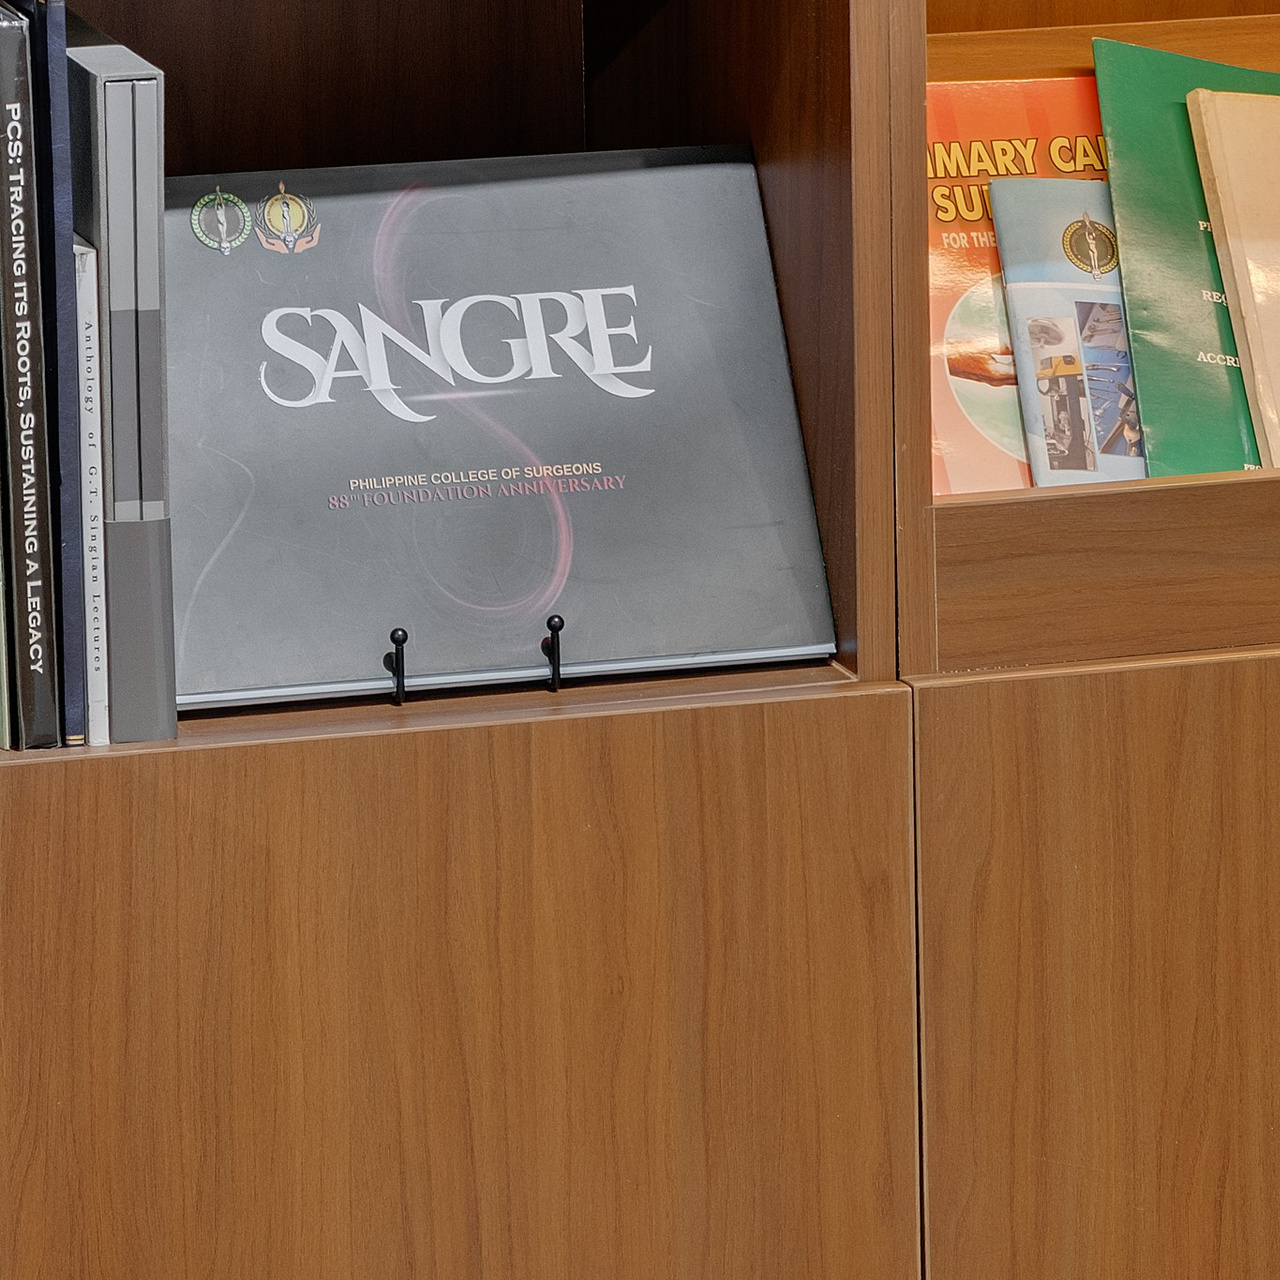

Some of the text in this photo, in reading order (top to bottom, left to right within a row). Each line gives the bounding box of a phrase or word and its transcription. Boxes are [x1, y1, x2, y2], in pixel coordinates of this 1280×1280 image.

[941, 230, 997, 249] FOR THE
[84, 321, 94, 414] Anthology
[258, 284, 656, 423] SANGRE
[6, 103, 43, 675] PCS: TRACING ITS ROOTS, SUSTAINING A LEGACY
[87, 432, 97, 449] of
[349, 462, 602, 490] PHILIPPINE COLLEGE OF SURGEONS
[362, 485, 492, 507] FOUNDATION
[497, 475, 627, 497] ANNIVERSARY
[89, 515, 99, 583] Singian
[92, 593, 101, 673] Lectures
